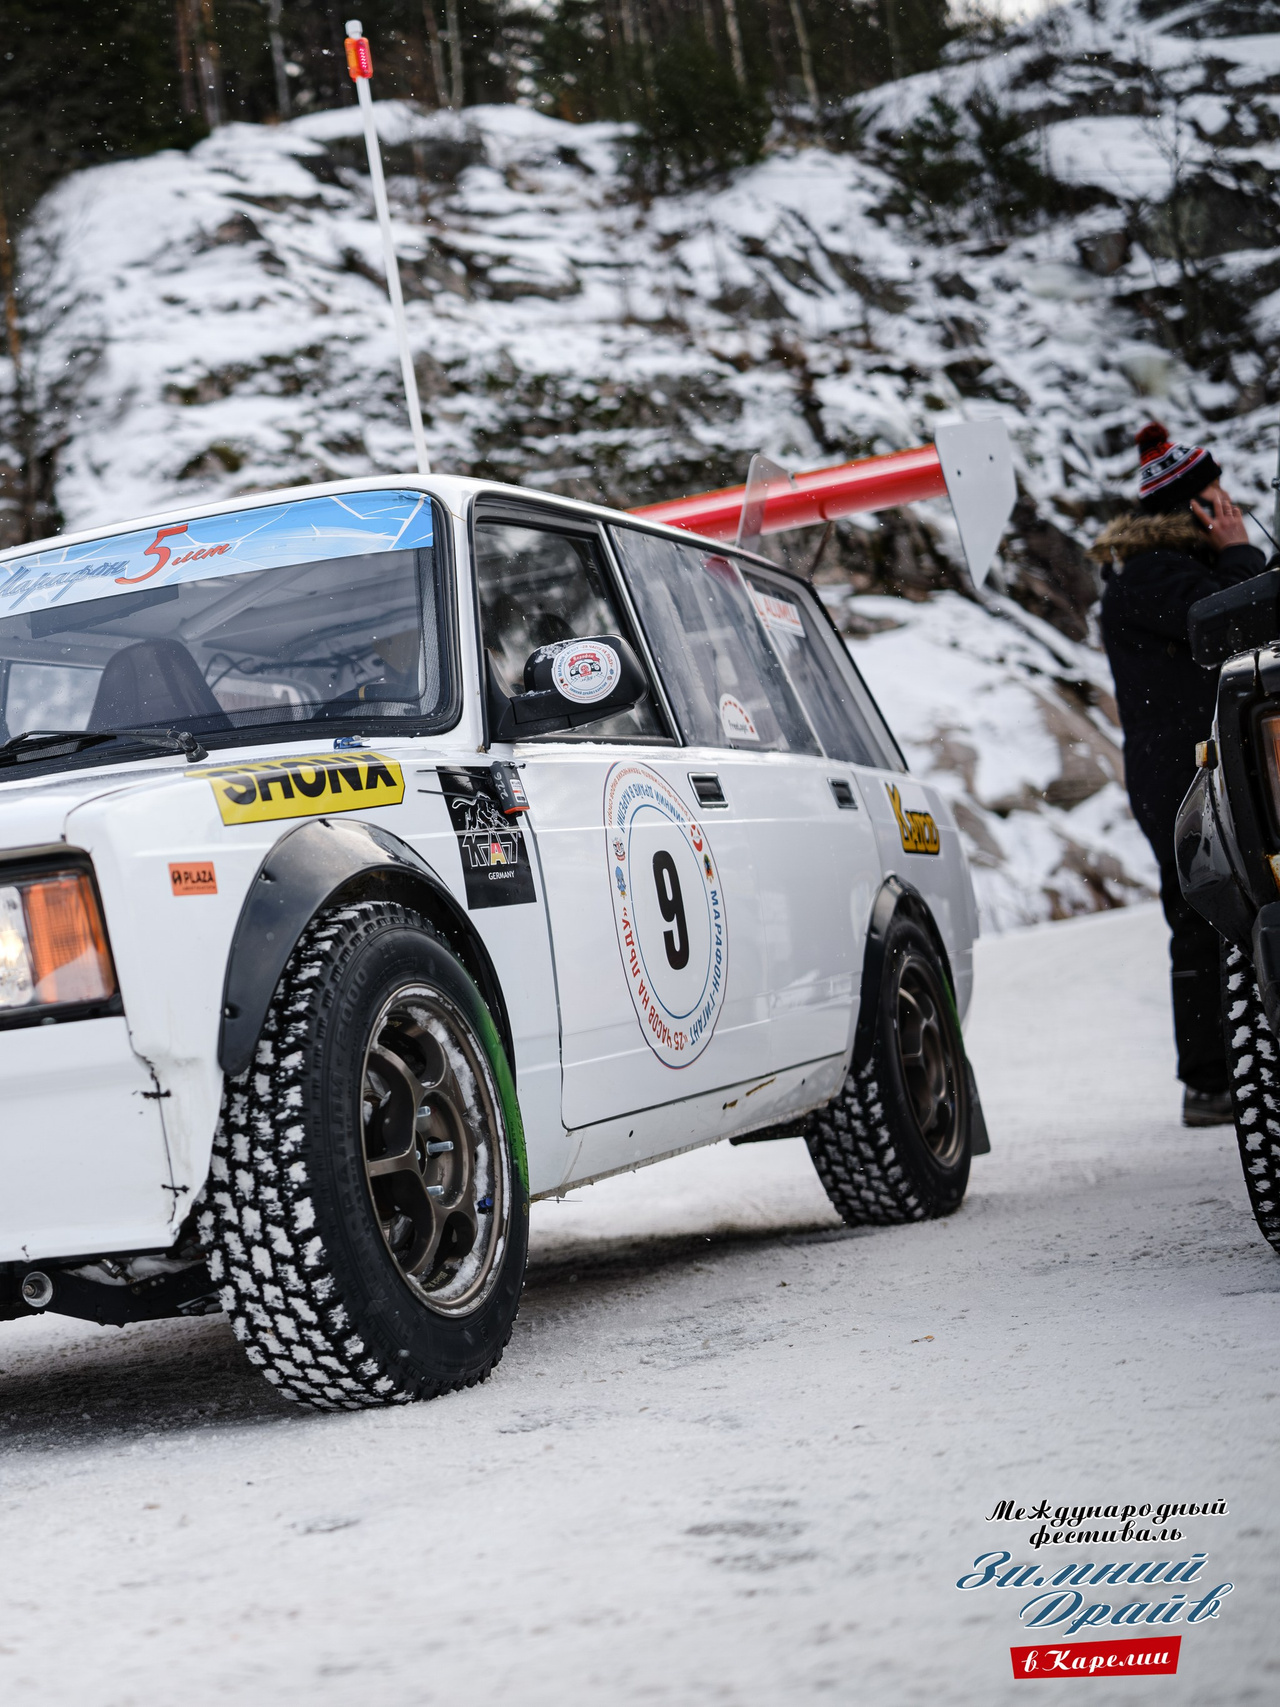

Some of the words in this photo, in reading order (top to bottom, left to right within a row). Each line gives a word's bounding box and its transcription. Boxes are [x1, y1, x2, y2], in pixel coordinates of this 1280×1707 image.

[115, 523, 189, 585] 5
[171, 542, 233, 566] лет
[206, 754, 398, 805] SHONX
[183, 870, 214, 884] PLAZA
[487, 870, 515, 881] GERMANY
[652, 849, 690, 971] 9
[689, 889, 724, 1047] МАРАФОН-ГИГАНТ
[637, 979, 650, 1011] НА
[648, 1005, 673, 1049] ЧАСОВ
